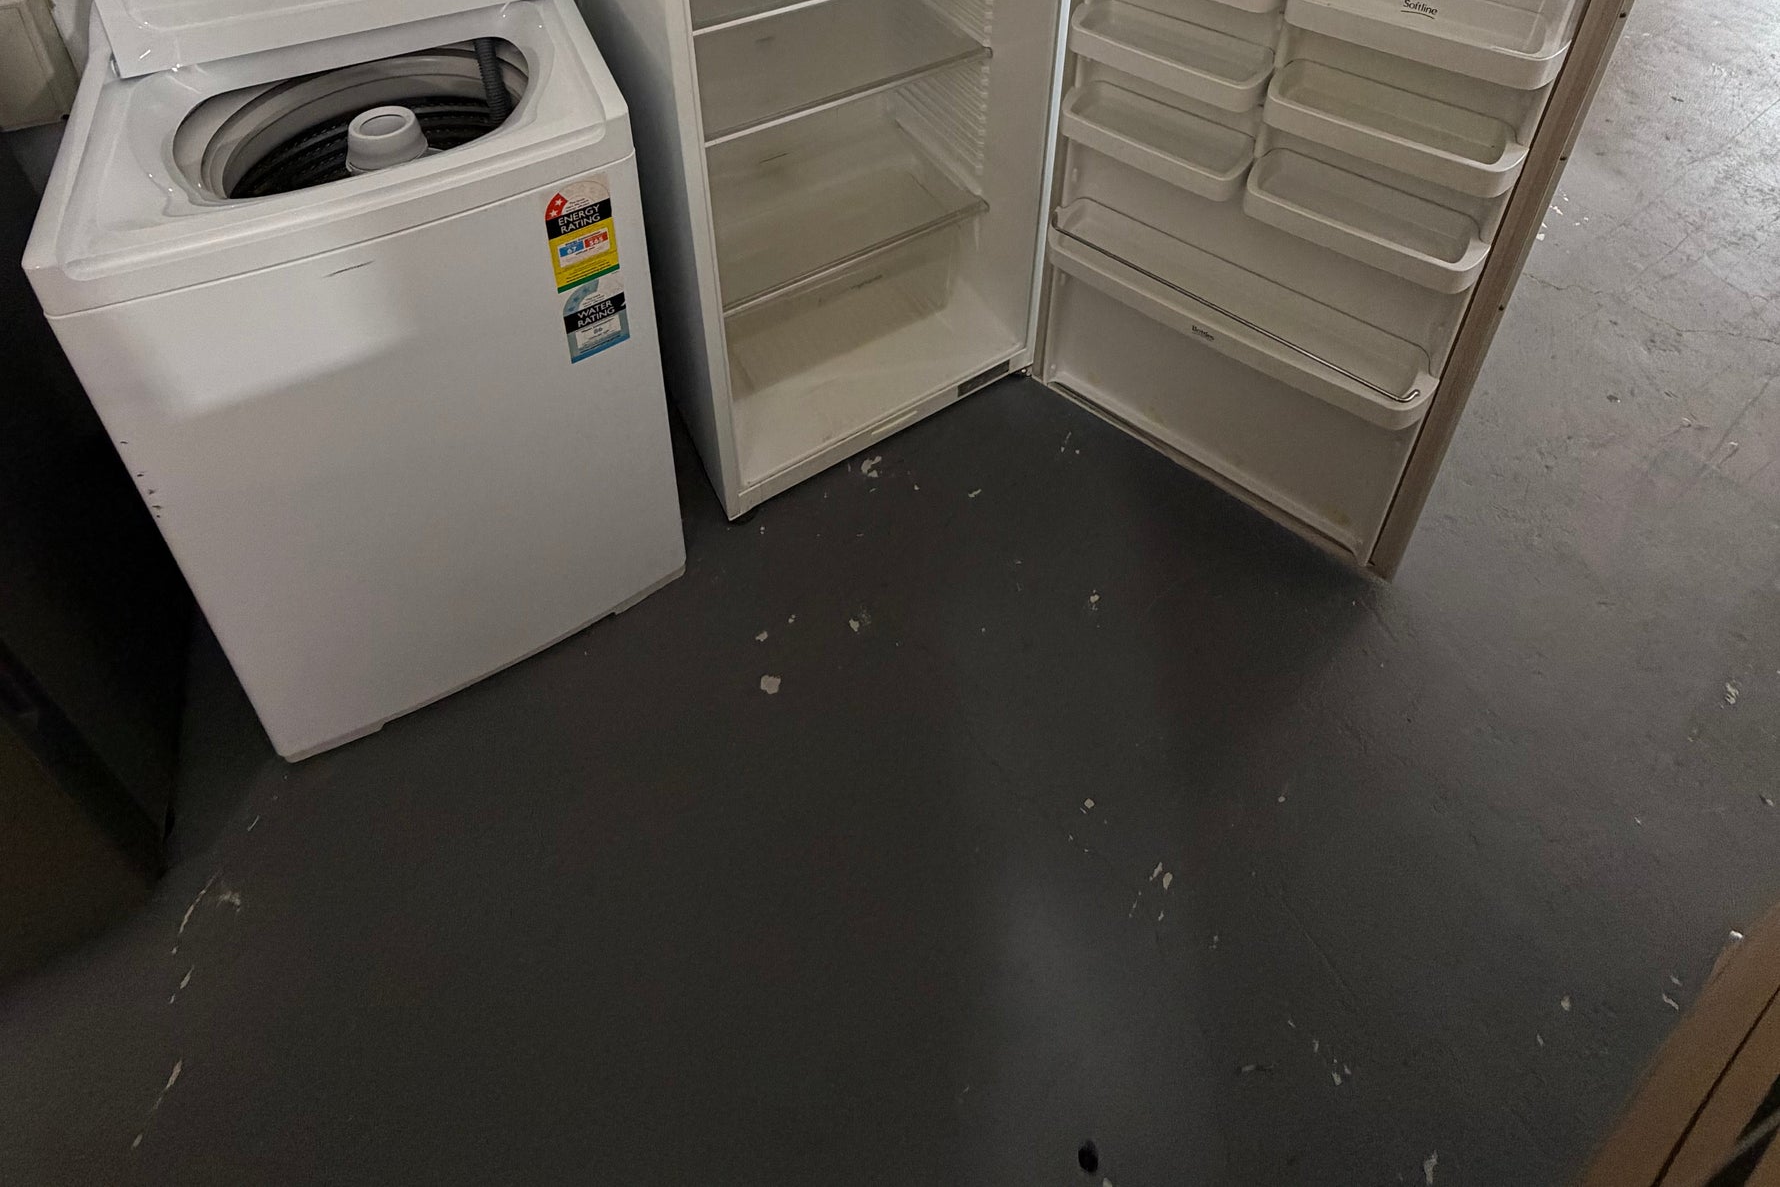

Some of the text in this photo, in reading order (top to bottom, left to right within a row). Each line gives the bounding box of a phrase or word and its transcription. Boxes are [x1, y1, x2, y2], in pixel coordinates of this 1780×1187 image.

[1403, 0, 1438, 15] Softline
[558, 204, 600, 226] ENERGY
[560, 214, 601, 234] RATING
[577, 307, 615, 328] RATING
[578, 300, 612, 318] WATER
